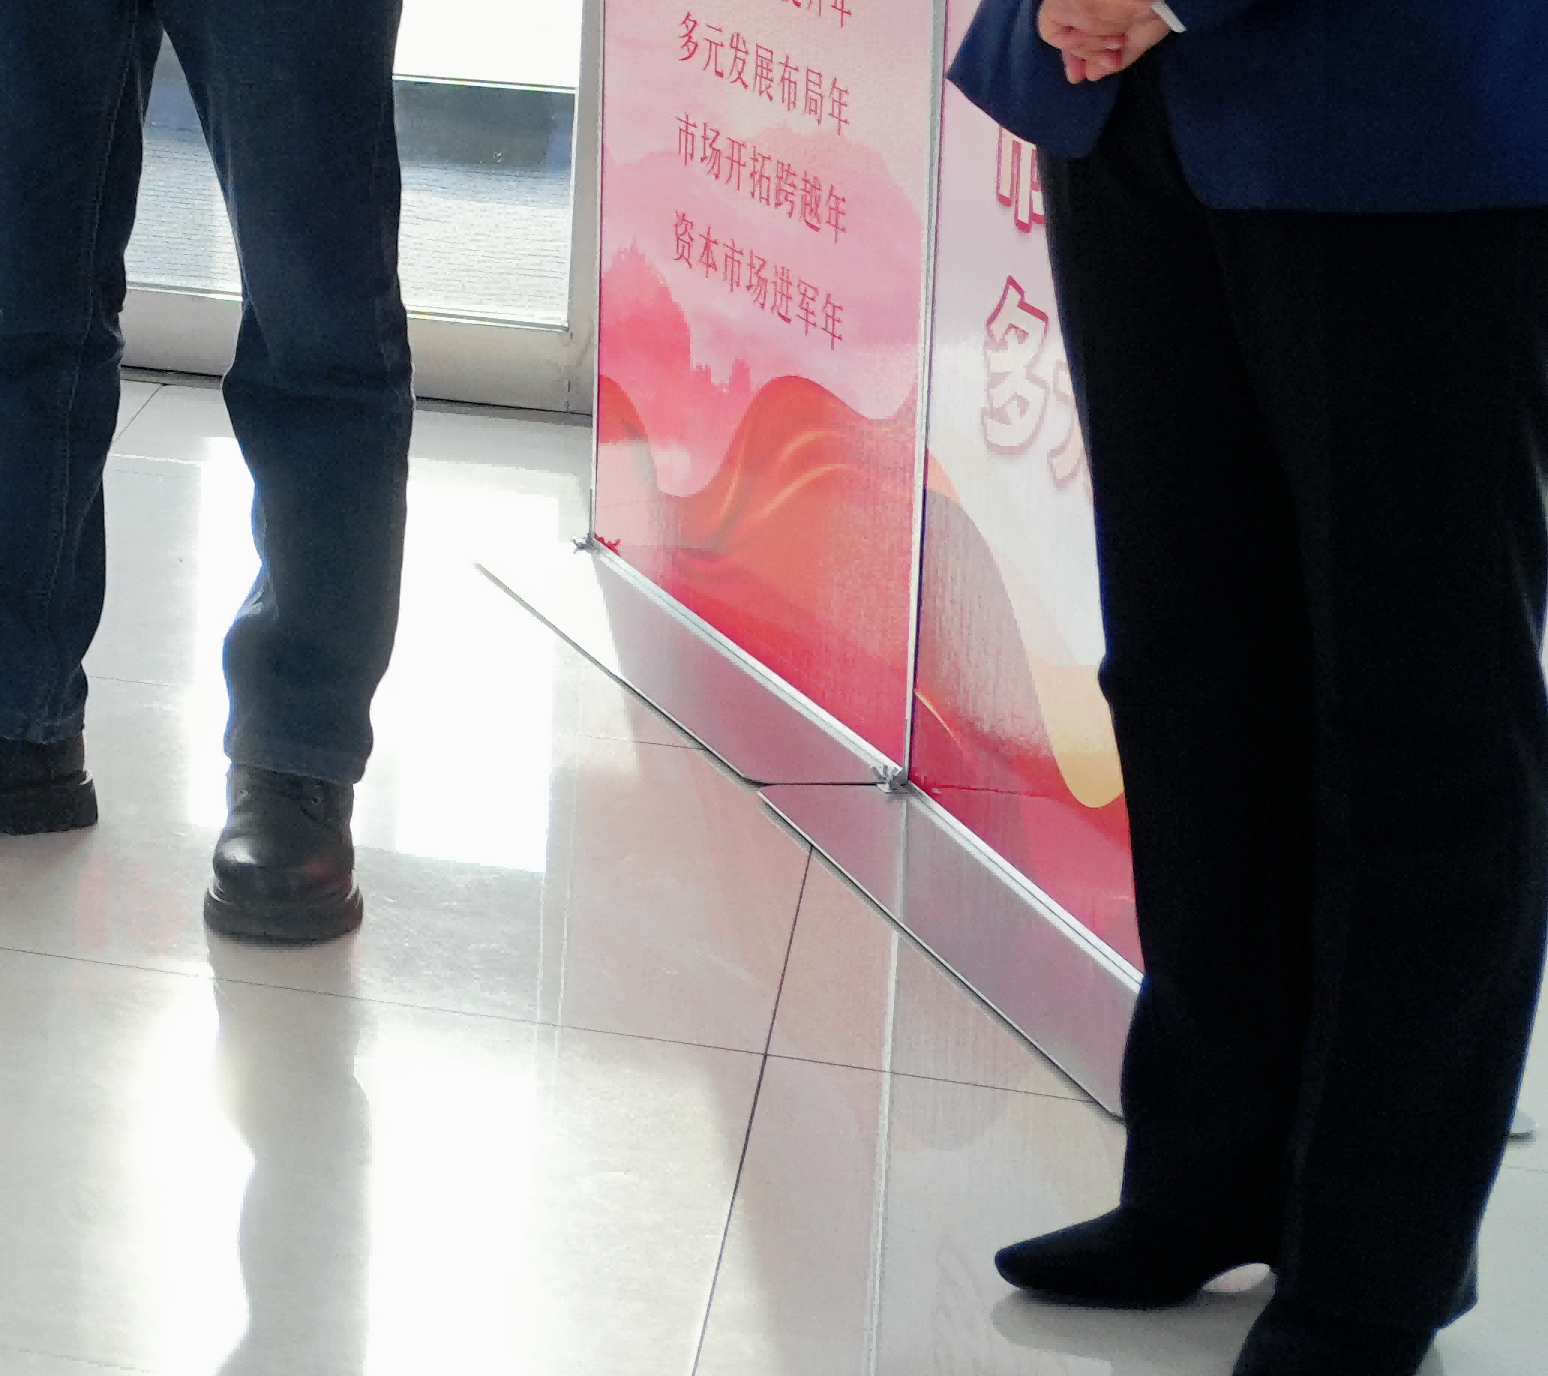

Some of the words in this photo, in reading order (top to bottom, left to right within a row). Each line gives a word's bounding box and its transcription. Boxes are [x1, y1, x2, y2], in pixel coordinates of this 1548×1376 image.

[677, 10, 850, 136] 多元发展布局年
[675, 111, 848, 244] 市场开拓跨越年
[673, 210, 844, 351] 资本市场进军年
